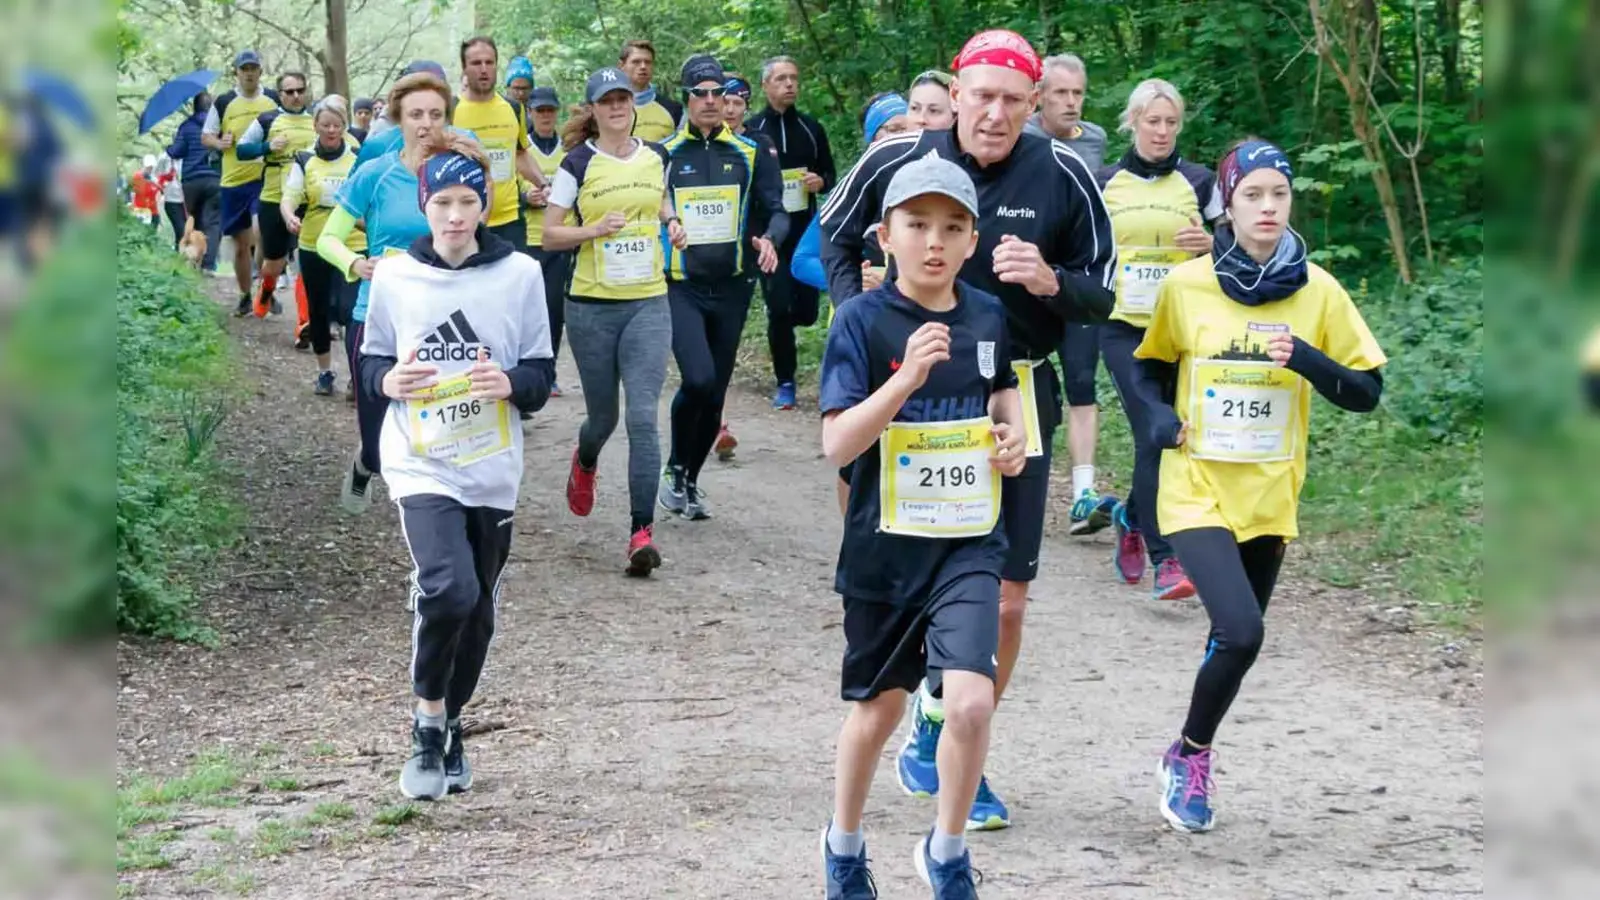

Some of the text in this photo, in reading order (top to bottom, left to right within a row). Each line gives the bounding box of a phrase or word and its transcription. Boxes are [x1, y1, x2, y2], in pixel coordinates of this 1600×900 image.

[695, 203, 724, 216] 1830
[996, 205, 1036, 219] Martin
[615, 241, 645, 254] 2143
[436, 399, 482, 425] 1796
[1222, 399, 1272, 418] 2154
[919, 464, 976, 487] 2196
